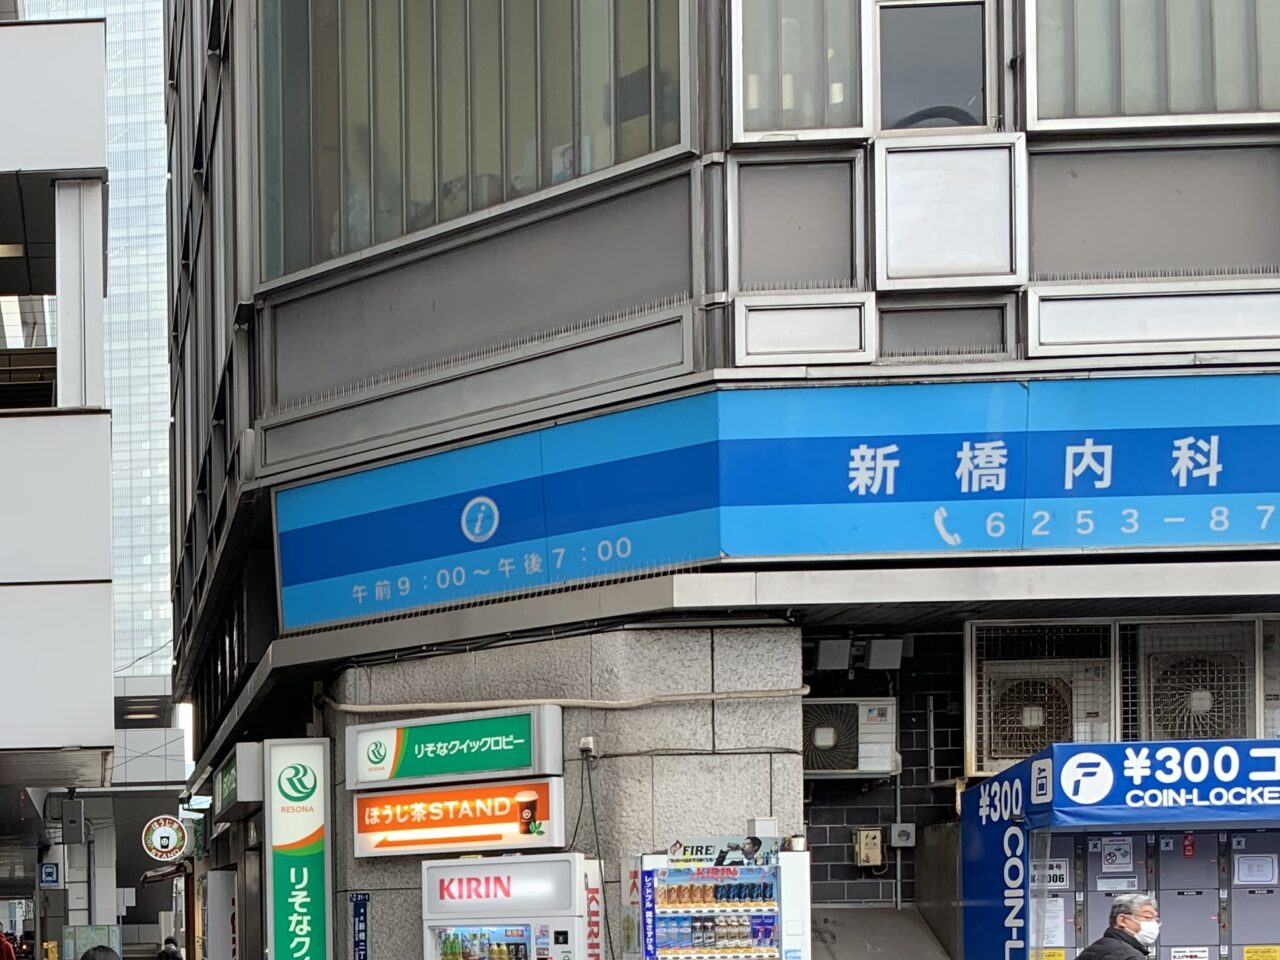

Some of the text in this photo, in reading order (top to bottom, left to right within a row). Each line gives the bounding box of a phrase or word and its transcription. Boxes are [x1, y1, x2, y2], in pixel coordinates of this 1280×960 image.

[848, 434, 1223, 496] 新橋内科
[414, 735, 525, 759] りそなクイックロビー
[281, 805, 315, 814] RESONA
[683, 845, 714, 856] FIRE
[439, 875, 511, 901] KIRIN
